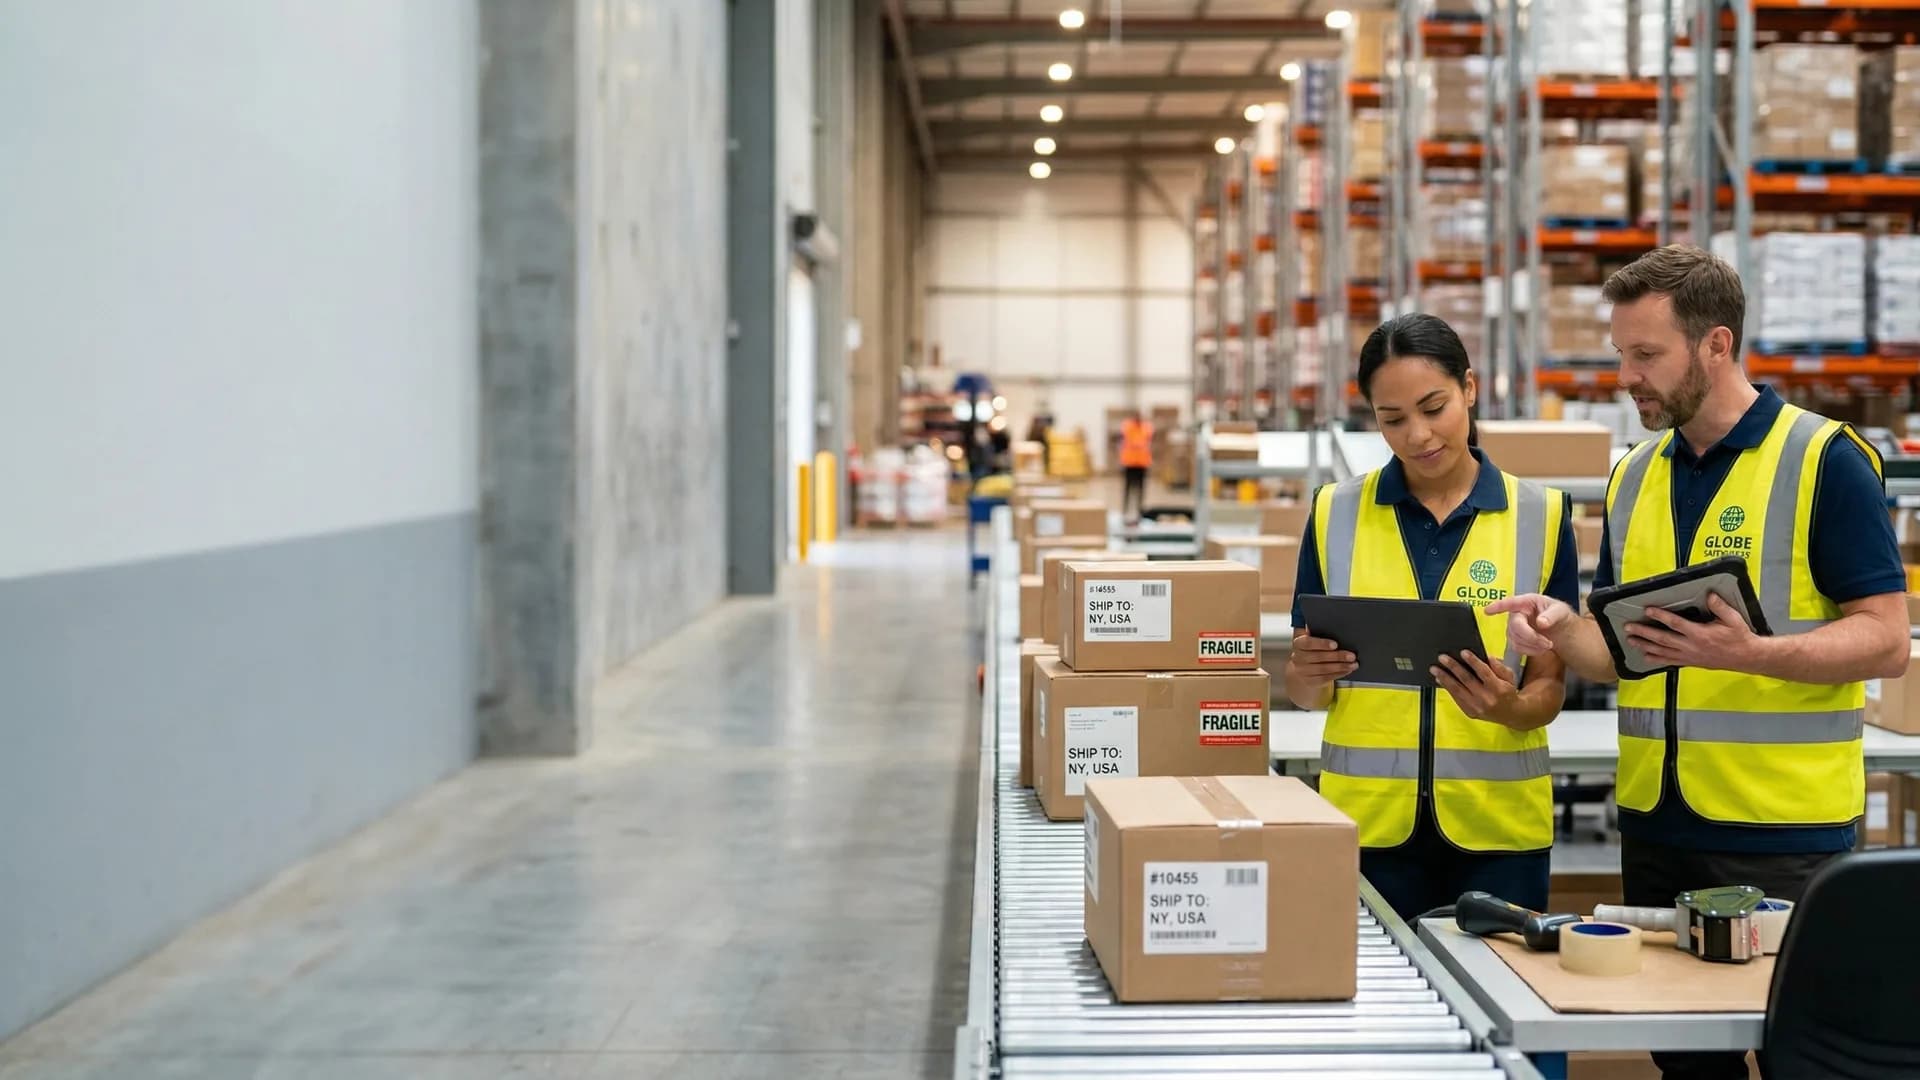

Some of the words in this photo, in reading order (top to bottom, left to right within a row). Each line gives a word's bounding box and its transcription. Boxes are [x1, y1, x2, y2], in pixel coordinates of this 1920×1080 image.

[1705, 536, 1752, 549] GLOBE
[1089, 601, 1114, 611] SHIP
[1116, 601, 1134, 611] TO:
[1089, 614, 1107, 625] NY,
[1109, 614, 1131, 624] USA
[1200, 640, 1253, 655] FRAGILE
[1202, 714, 1259, 730] FRAGILE
[1068, 747, 1098, 759] SHIP
[1100, 747, 1122, 759] TO:
[1068, 762, 1089, 776] NY,
[1092, 762, 1119, 774] USA
[1150, 872, 1199, 885] #10455
[1150, 894, 1182, 908] SHIP
[1186, 894, 1210, 907] TO:
[1150, 912, 1173, 926] NY,
[1177, 912, 1206, 924] USA
